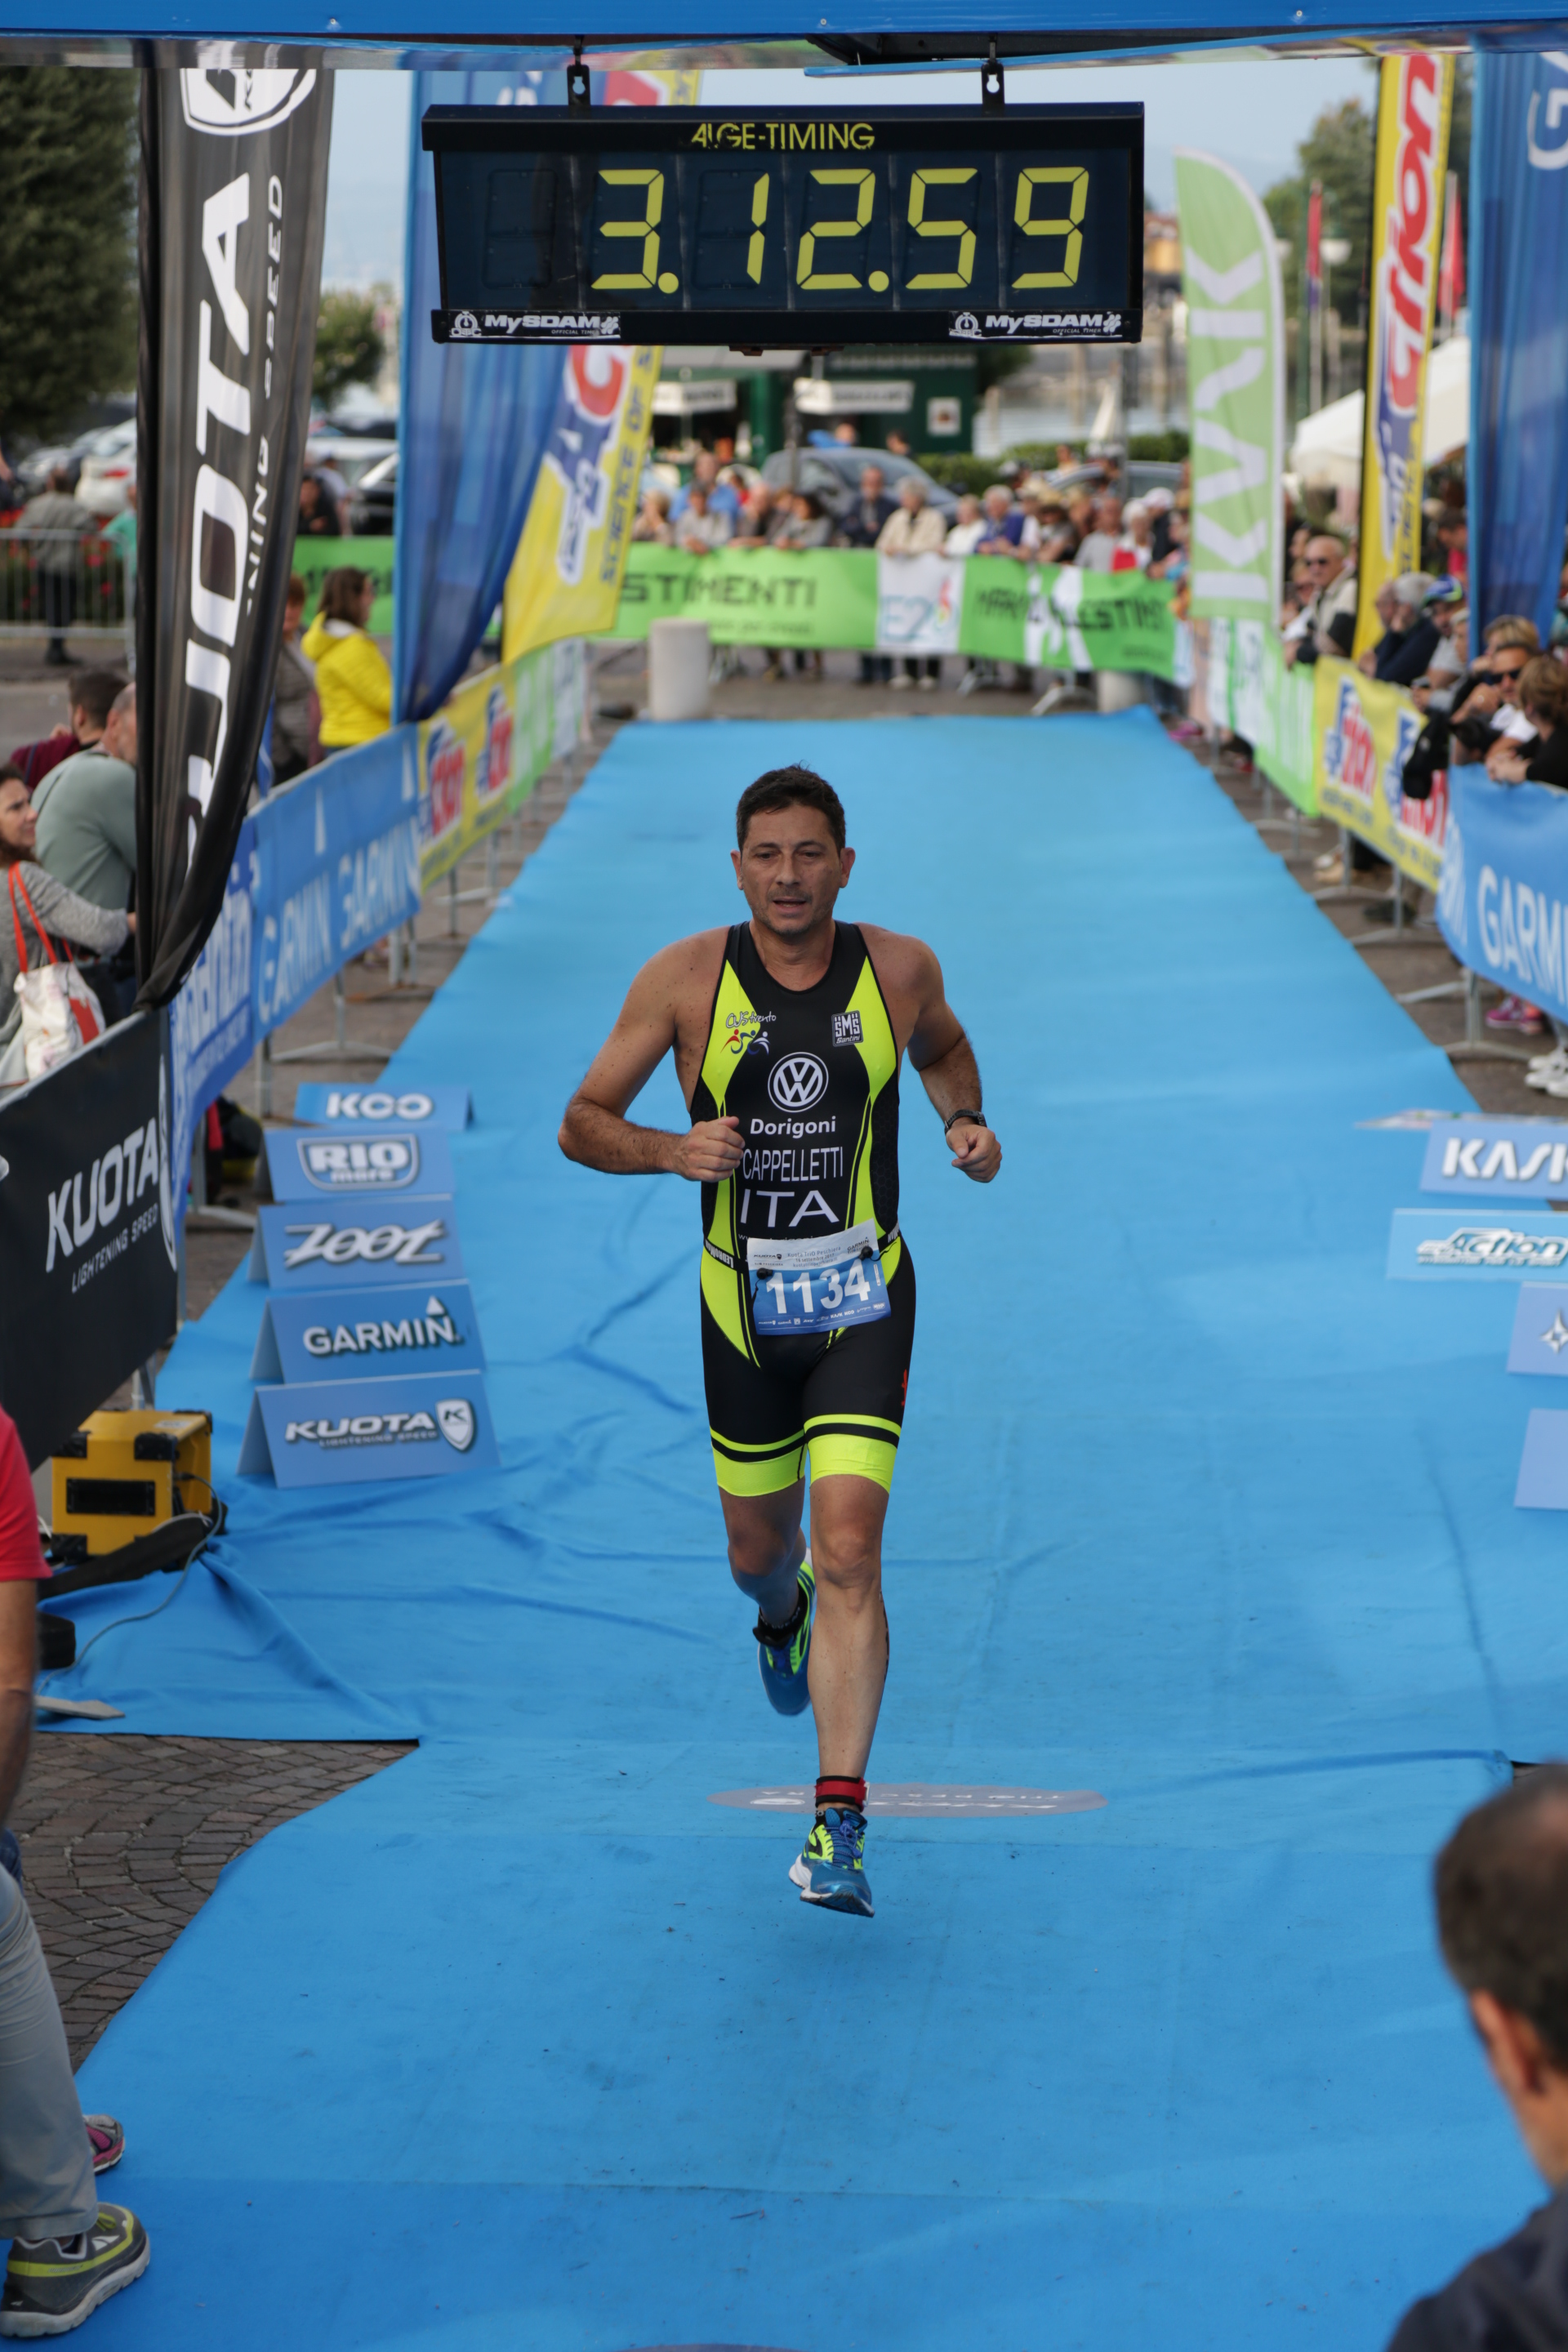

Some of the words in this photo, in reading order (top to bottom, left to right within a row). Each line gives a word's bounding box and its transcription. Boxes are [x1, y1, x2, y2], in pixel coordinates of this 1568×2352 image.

[484, 314, 601, 334] MySDAM
[985, 314, 1103, 334] MySDAM
[185, 172, 252, 882] UOTA
[835, 1035, 861, 1044] Santini
[750, 1116, 836, 1139] Dorigoni
[308, 1142, 409, 1172] RIO
[743, 1147, 844, 1182] CAPPELLETTI
[46, 1116, 159, 1274] KUOTA
[740, 1188, 840, 1227] ITA
[72, 1227, 128, 1294] LIGHTENING
[131, 1202, 158, 1244] SPEED
[817, 1245, 841, 1256] Peschiera
[847, 1239, 870, 1251] GARMIN
[766, 1258, 871, 1314] 1134
[303, 1315, 456, 1355] GARMIN
[285, 1411, 436, 1441] KUOTA
